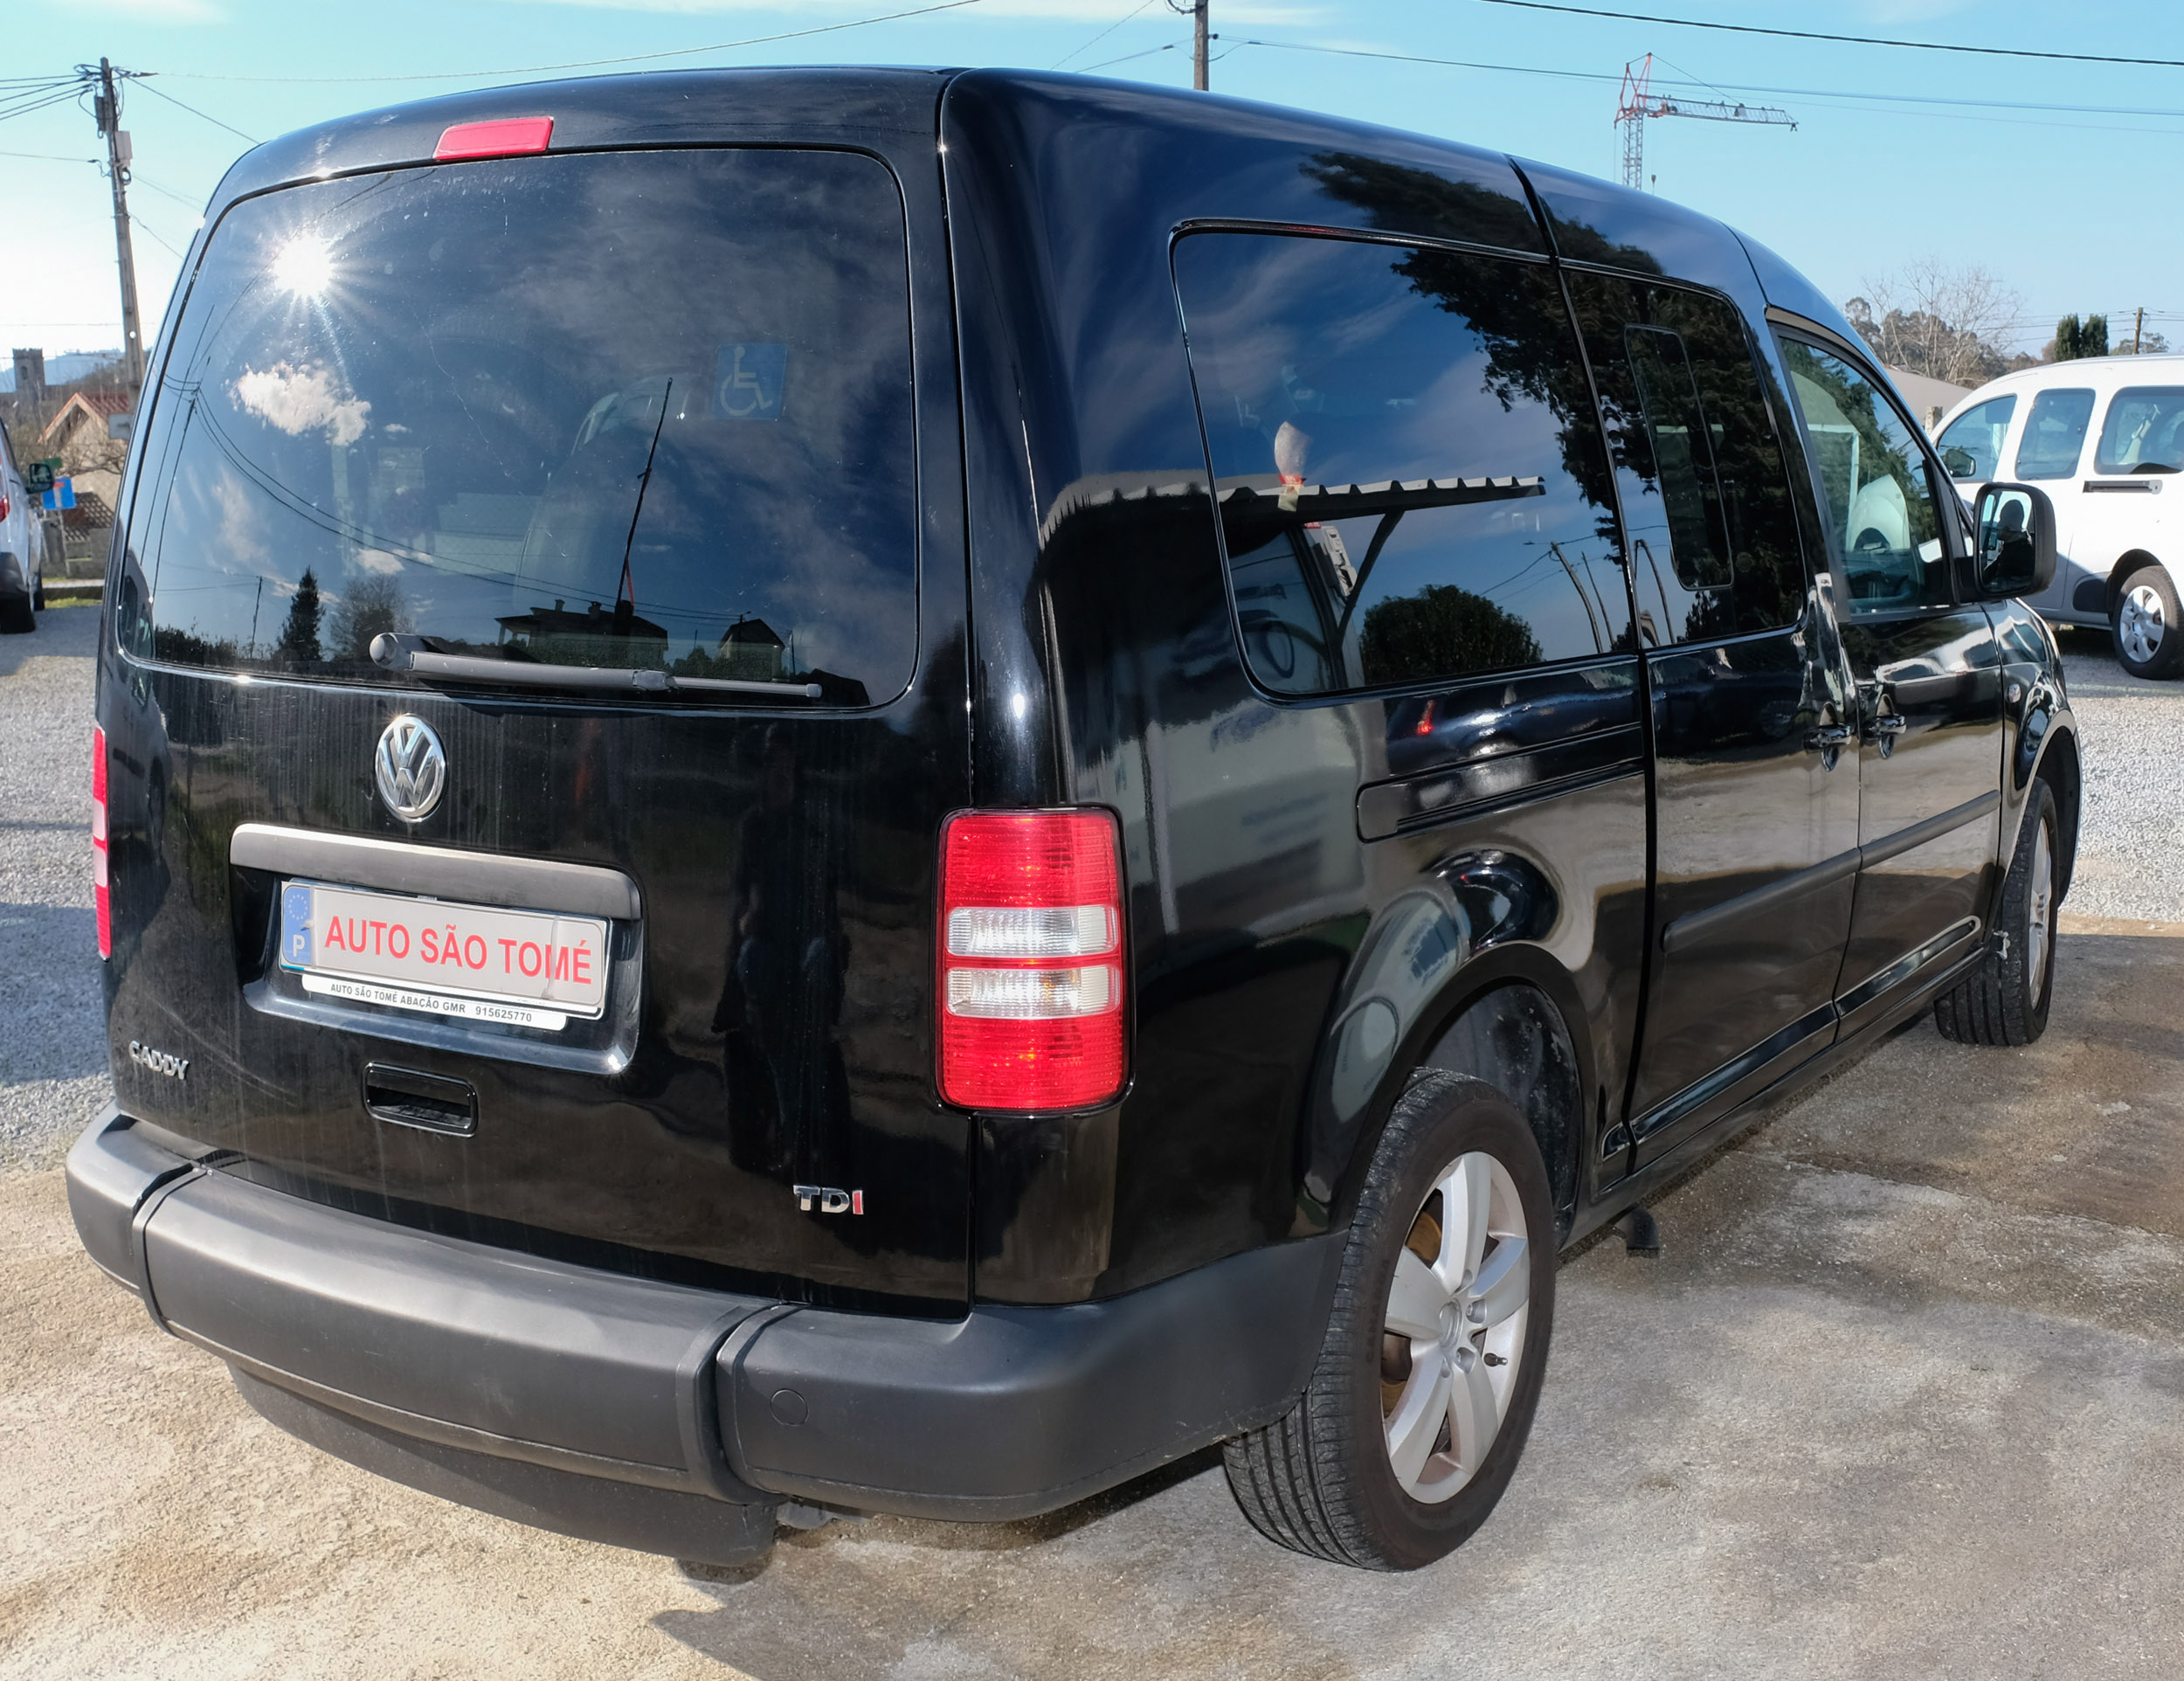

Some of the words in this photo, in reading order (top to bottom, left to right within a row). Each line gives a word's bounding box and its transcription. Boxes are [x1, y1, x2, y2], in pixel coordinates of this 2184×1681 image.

[293, 934, 305, 957] P
[325, 916, 410, 958] AUTO
[420, 924, 487, 970] SÃO
[498, 938, 591, 985] TOMÉ
[330, 984, 353, 995] AUTO
[355, 986, 371, 998] SÃO
[374, 990, 397, 1003] TOMÉ
[400, 996, 439, 1009] ABAÇÃO
[443, 1003, 466, 1013] GMR
[475, 1006, 532, 1022] 915625770
[128, 1041, 190, 1080] CADDY
[793, 1185, 864, 1214] TDI
